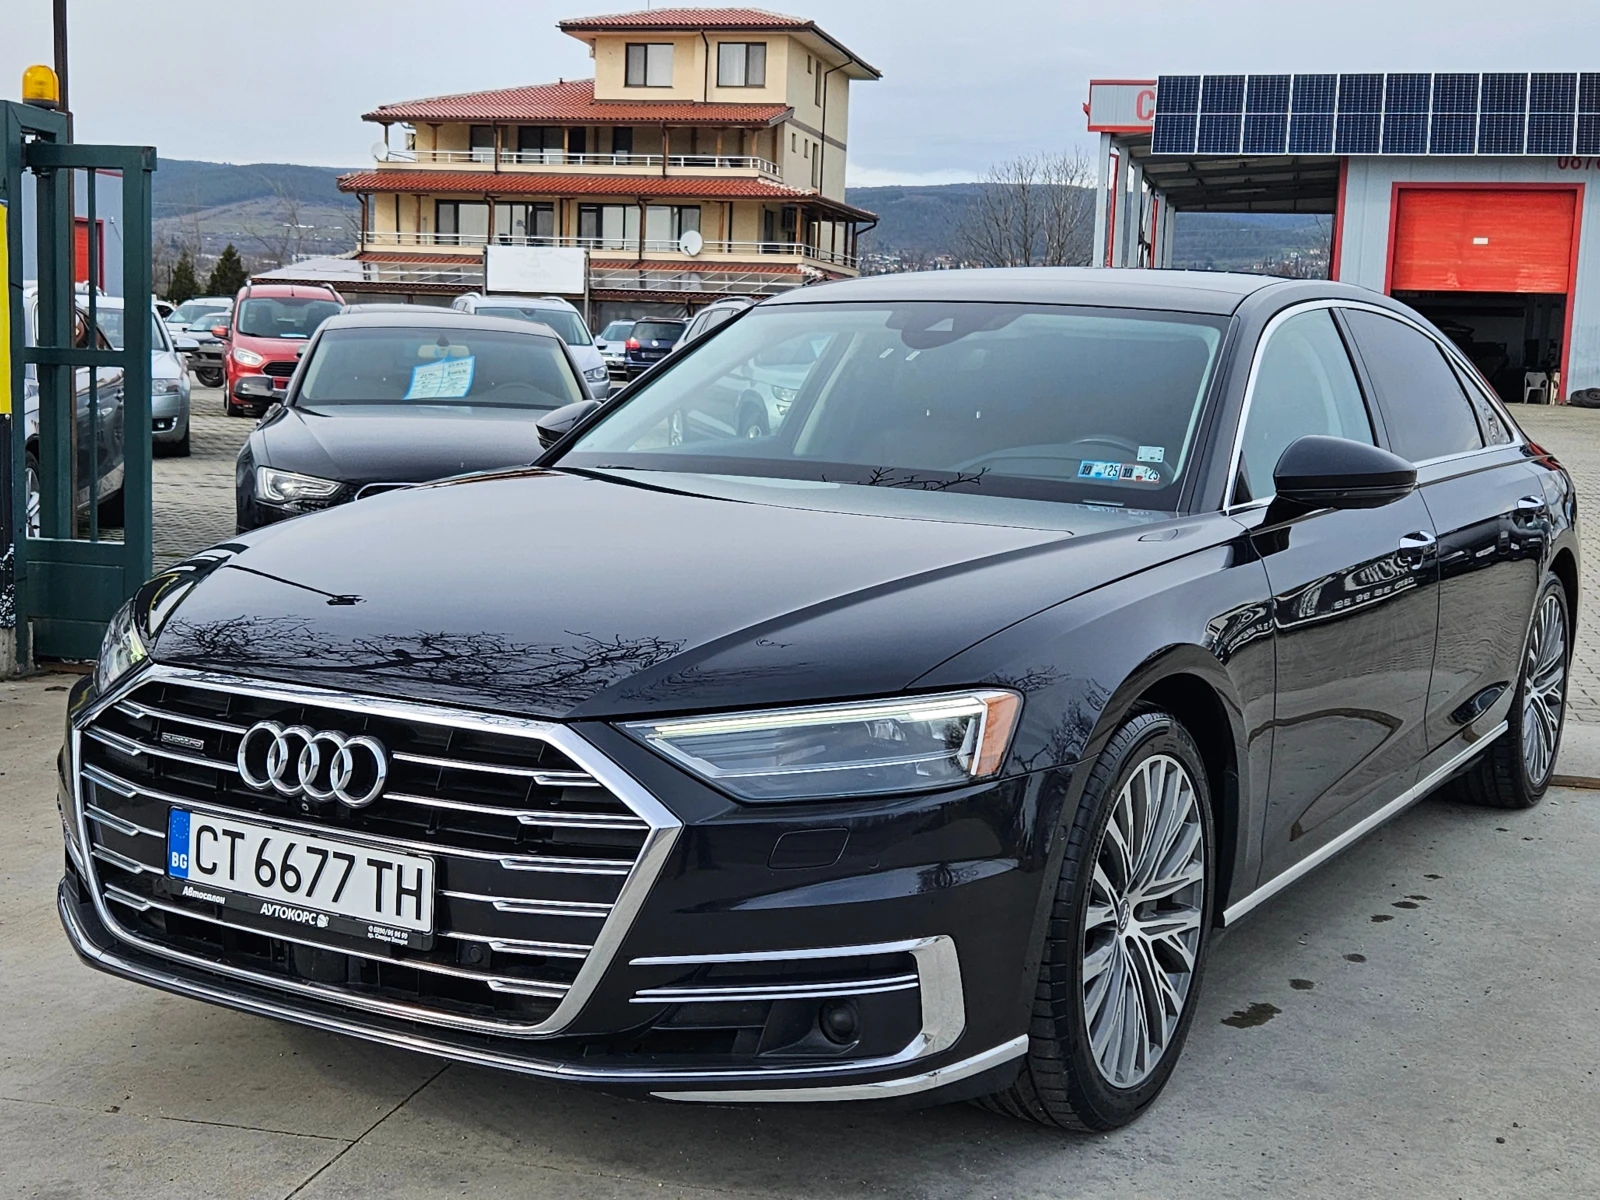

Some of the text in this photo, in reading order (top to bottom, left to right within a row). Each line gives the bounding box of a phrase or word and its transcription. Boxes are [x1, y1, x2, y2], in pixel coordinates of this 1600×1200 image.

[1108, 464, 1119, 477] 25
[171, 852, 188, 869] BG
[195, 824, 423, 921] CT 6677 TH
[260, 902, 316, 925] АУТОКОРС
